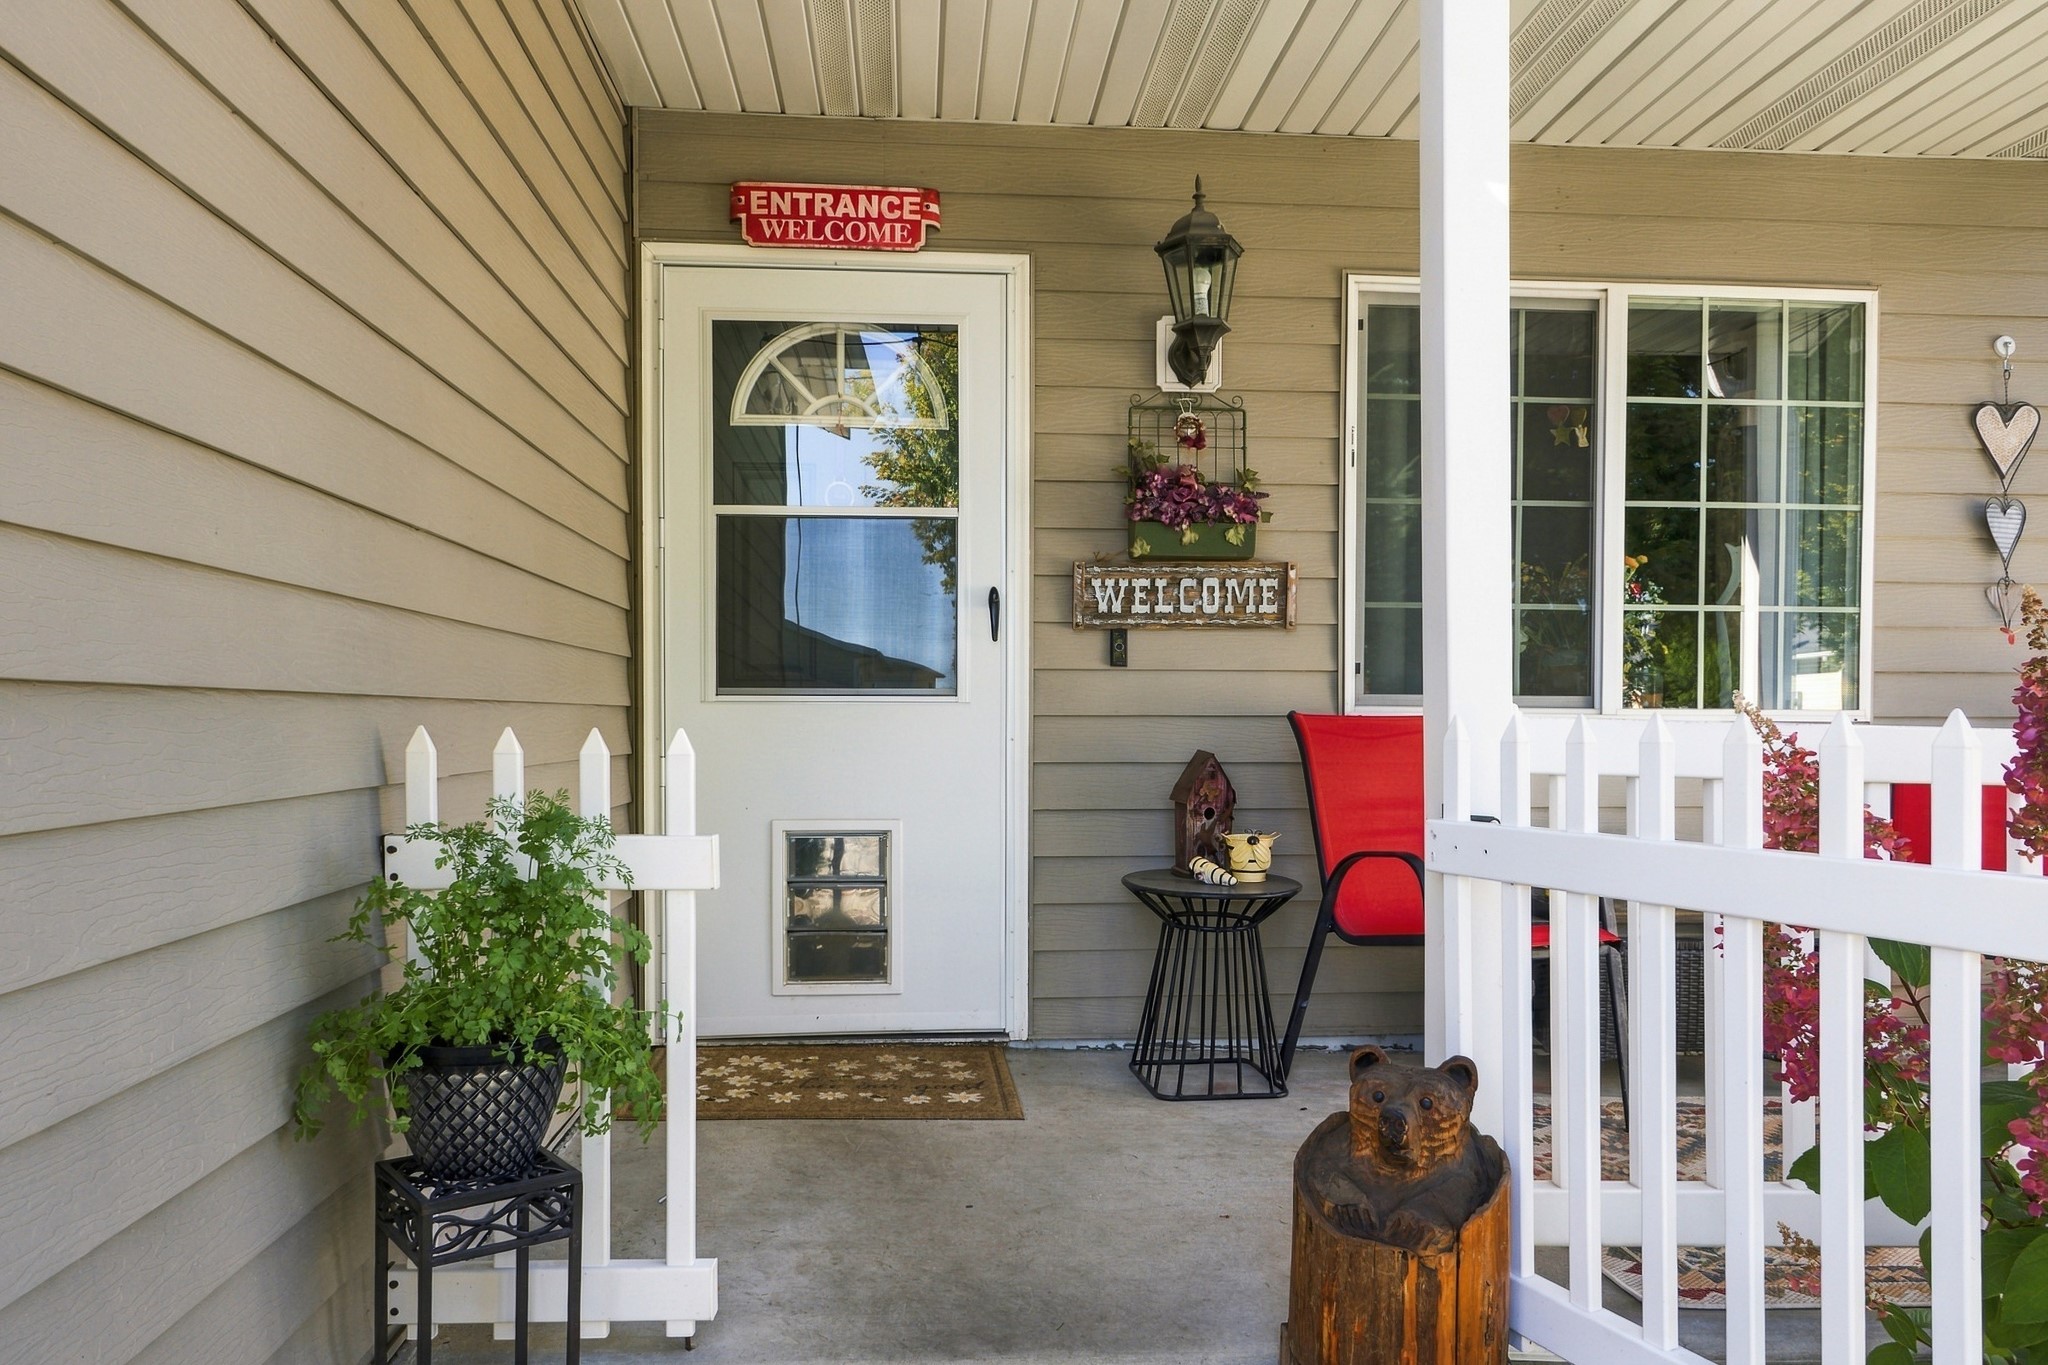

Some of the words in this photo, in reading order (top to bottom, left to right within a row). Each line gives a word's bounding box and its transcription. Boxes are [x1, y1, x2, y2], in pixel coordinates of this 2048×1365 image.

[750, 190, 921, 220] ENTRANCE
[759, 218, 912, 244] WELCOME
[1091, 577, 1279, 614] WELCOME
